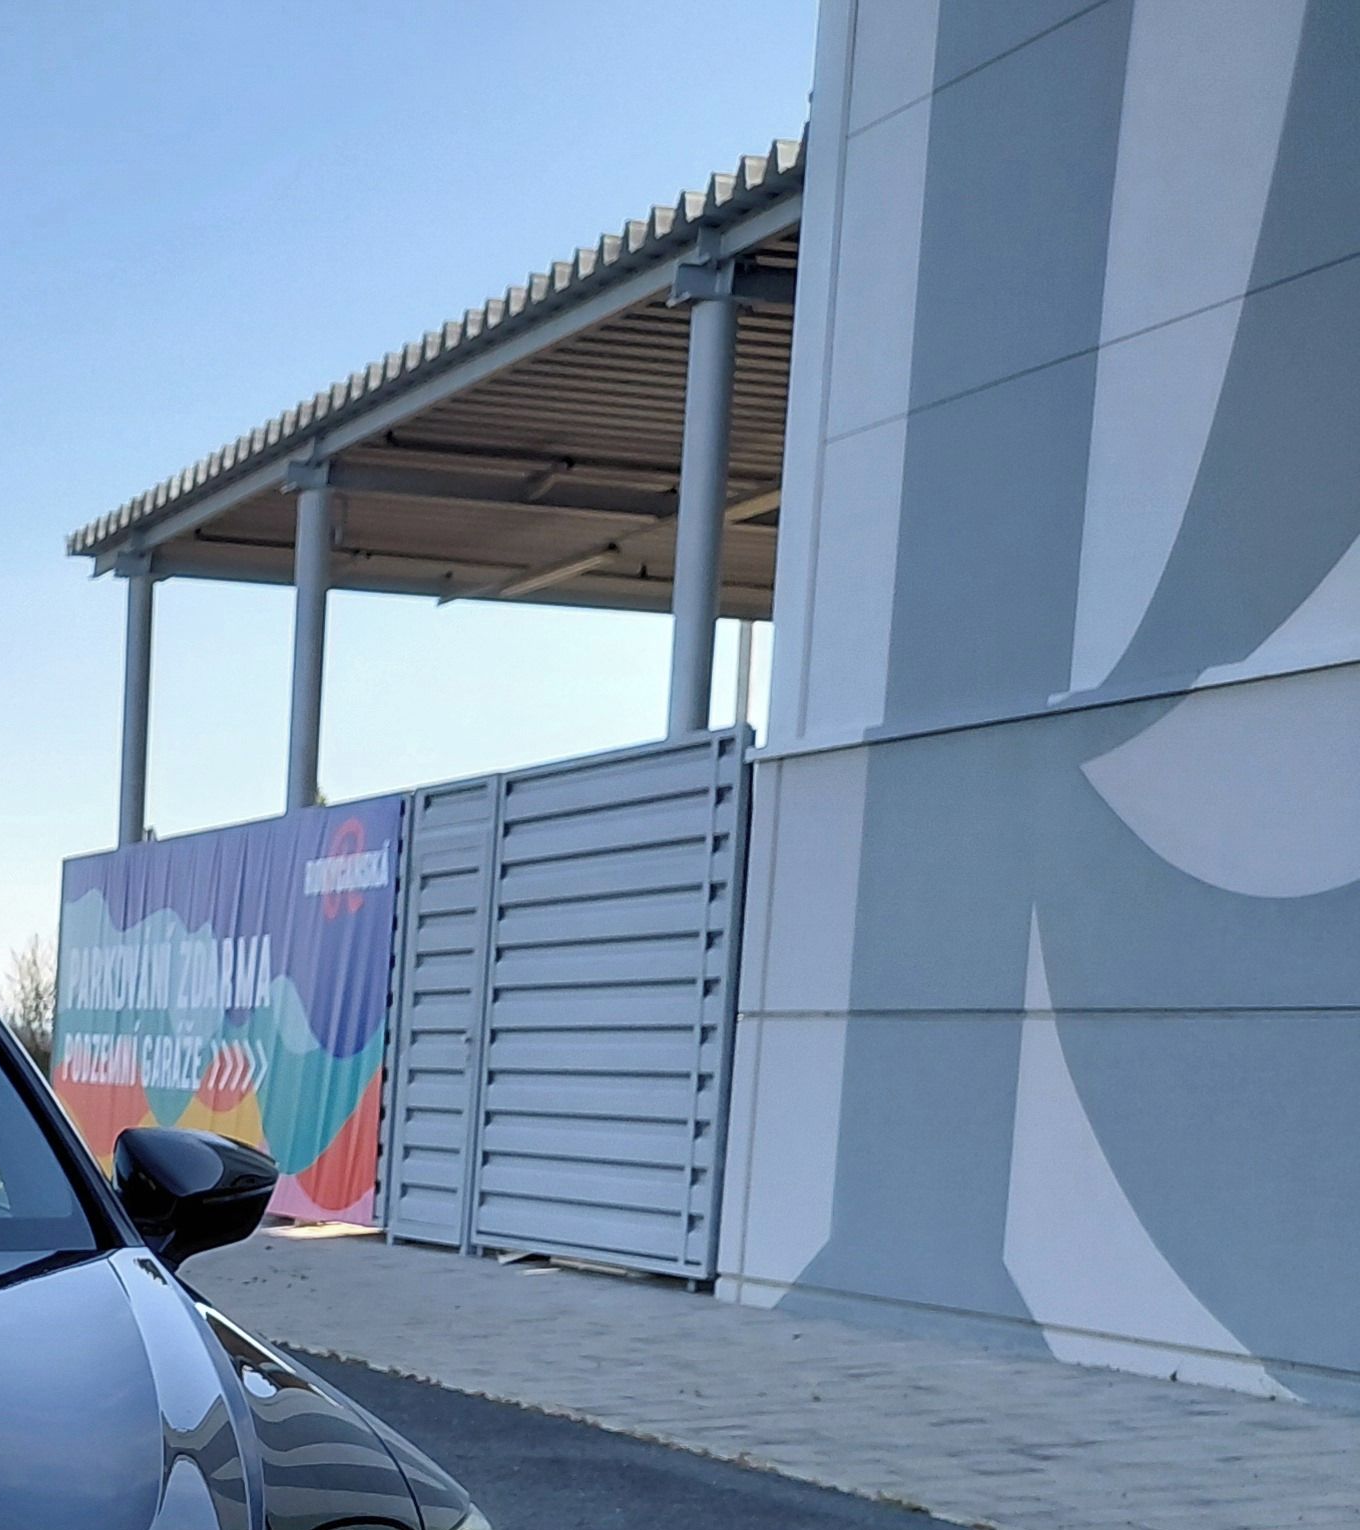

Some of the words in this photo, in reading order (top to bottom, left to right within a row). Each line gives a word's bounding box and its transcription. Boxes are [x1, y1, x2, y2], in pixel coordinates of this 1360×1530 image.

[68, 921, 175, 1009] PARKOVÁNÍ
[179, 934, 271, 1009] ZDARMA
[61, 1019, 141, 1087] PODZEMNÍ
[140, 1020, 204, 1091] GARÁŽE
